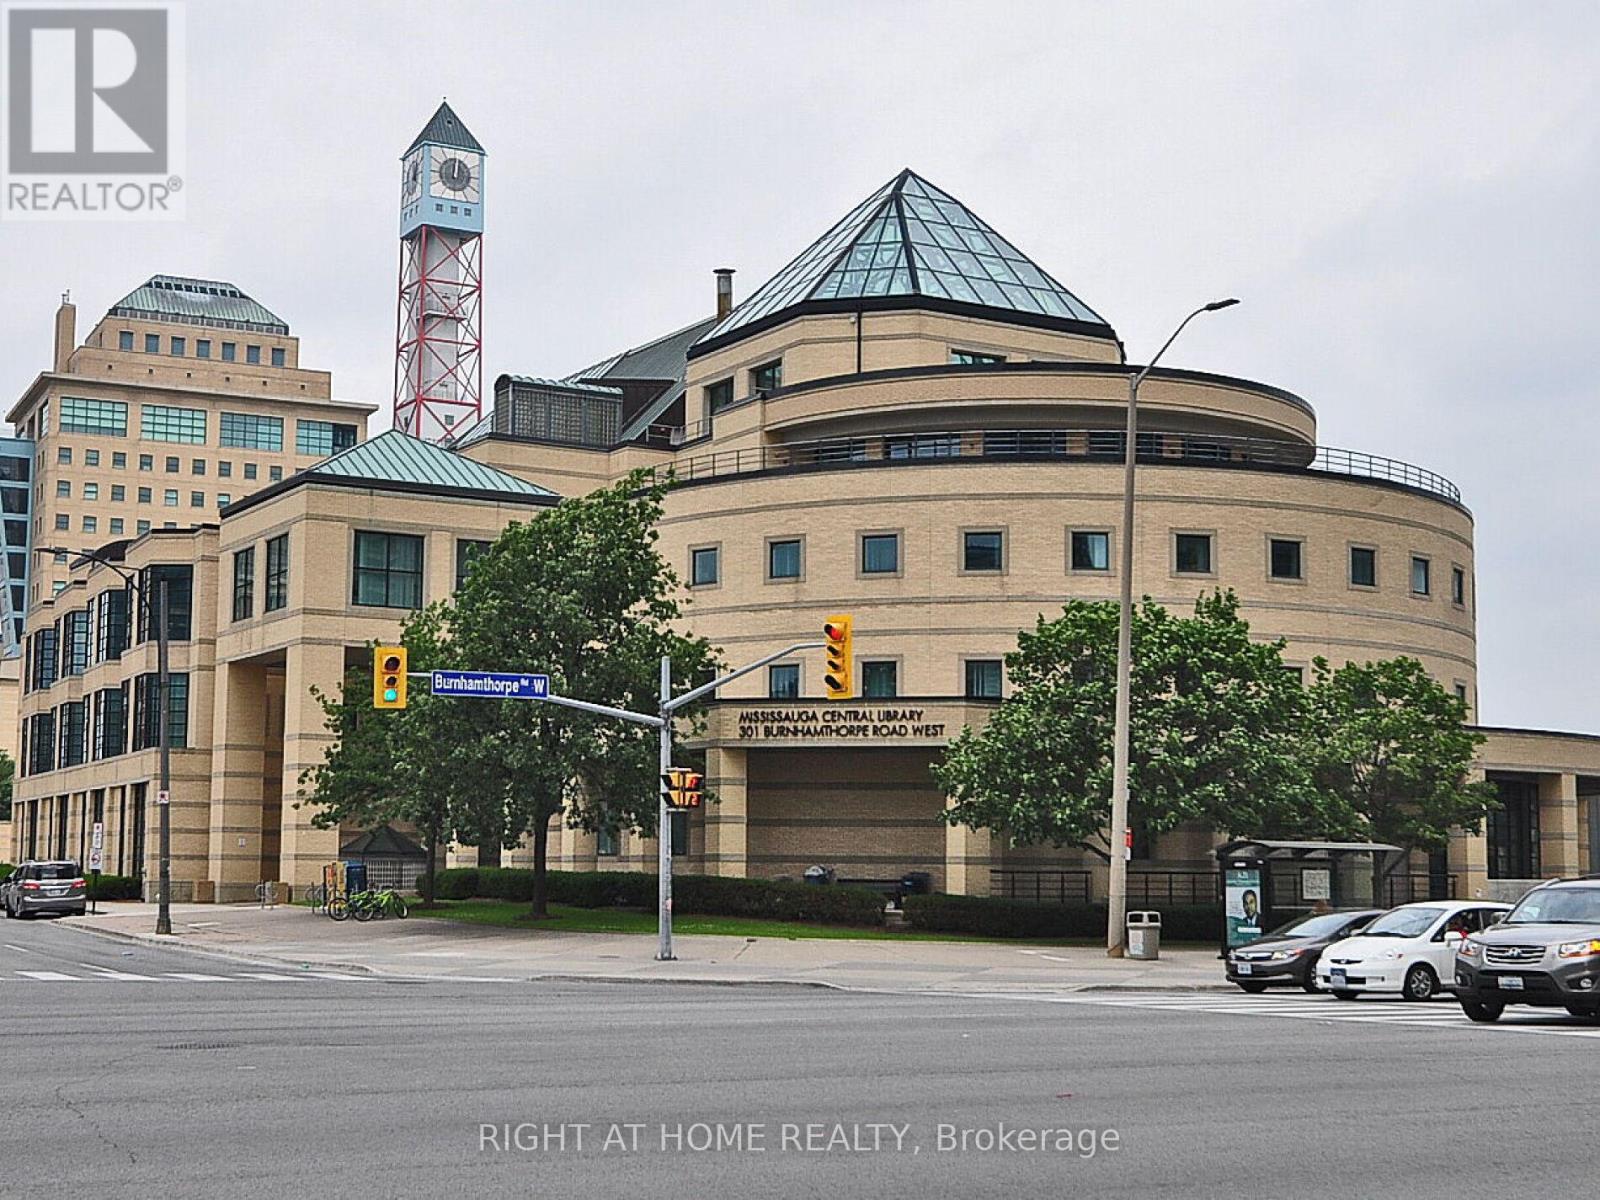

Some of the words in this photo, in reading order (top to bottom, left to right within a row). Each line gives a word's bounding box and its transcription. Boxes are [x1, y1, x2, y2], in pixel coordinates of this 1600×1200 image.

[434, 674, 519, 696] Burnhamthorpe
[533, 679, 545, 693] W
[738, 710, 818, 723] MISSISSAUGA
[822, 710, 875, 723] CENTRAL
[878, 710, 924, 722] LIBRARY
[738, 725, 759, 739] 301
[763, 724, 869, 738] BURNHAMTHORPE
[872, 724, 908, 737] ROAD
[912, 724, 945, 737] WEST
